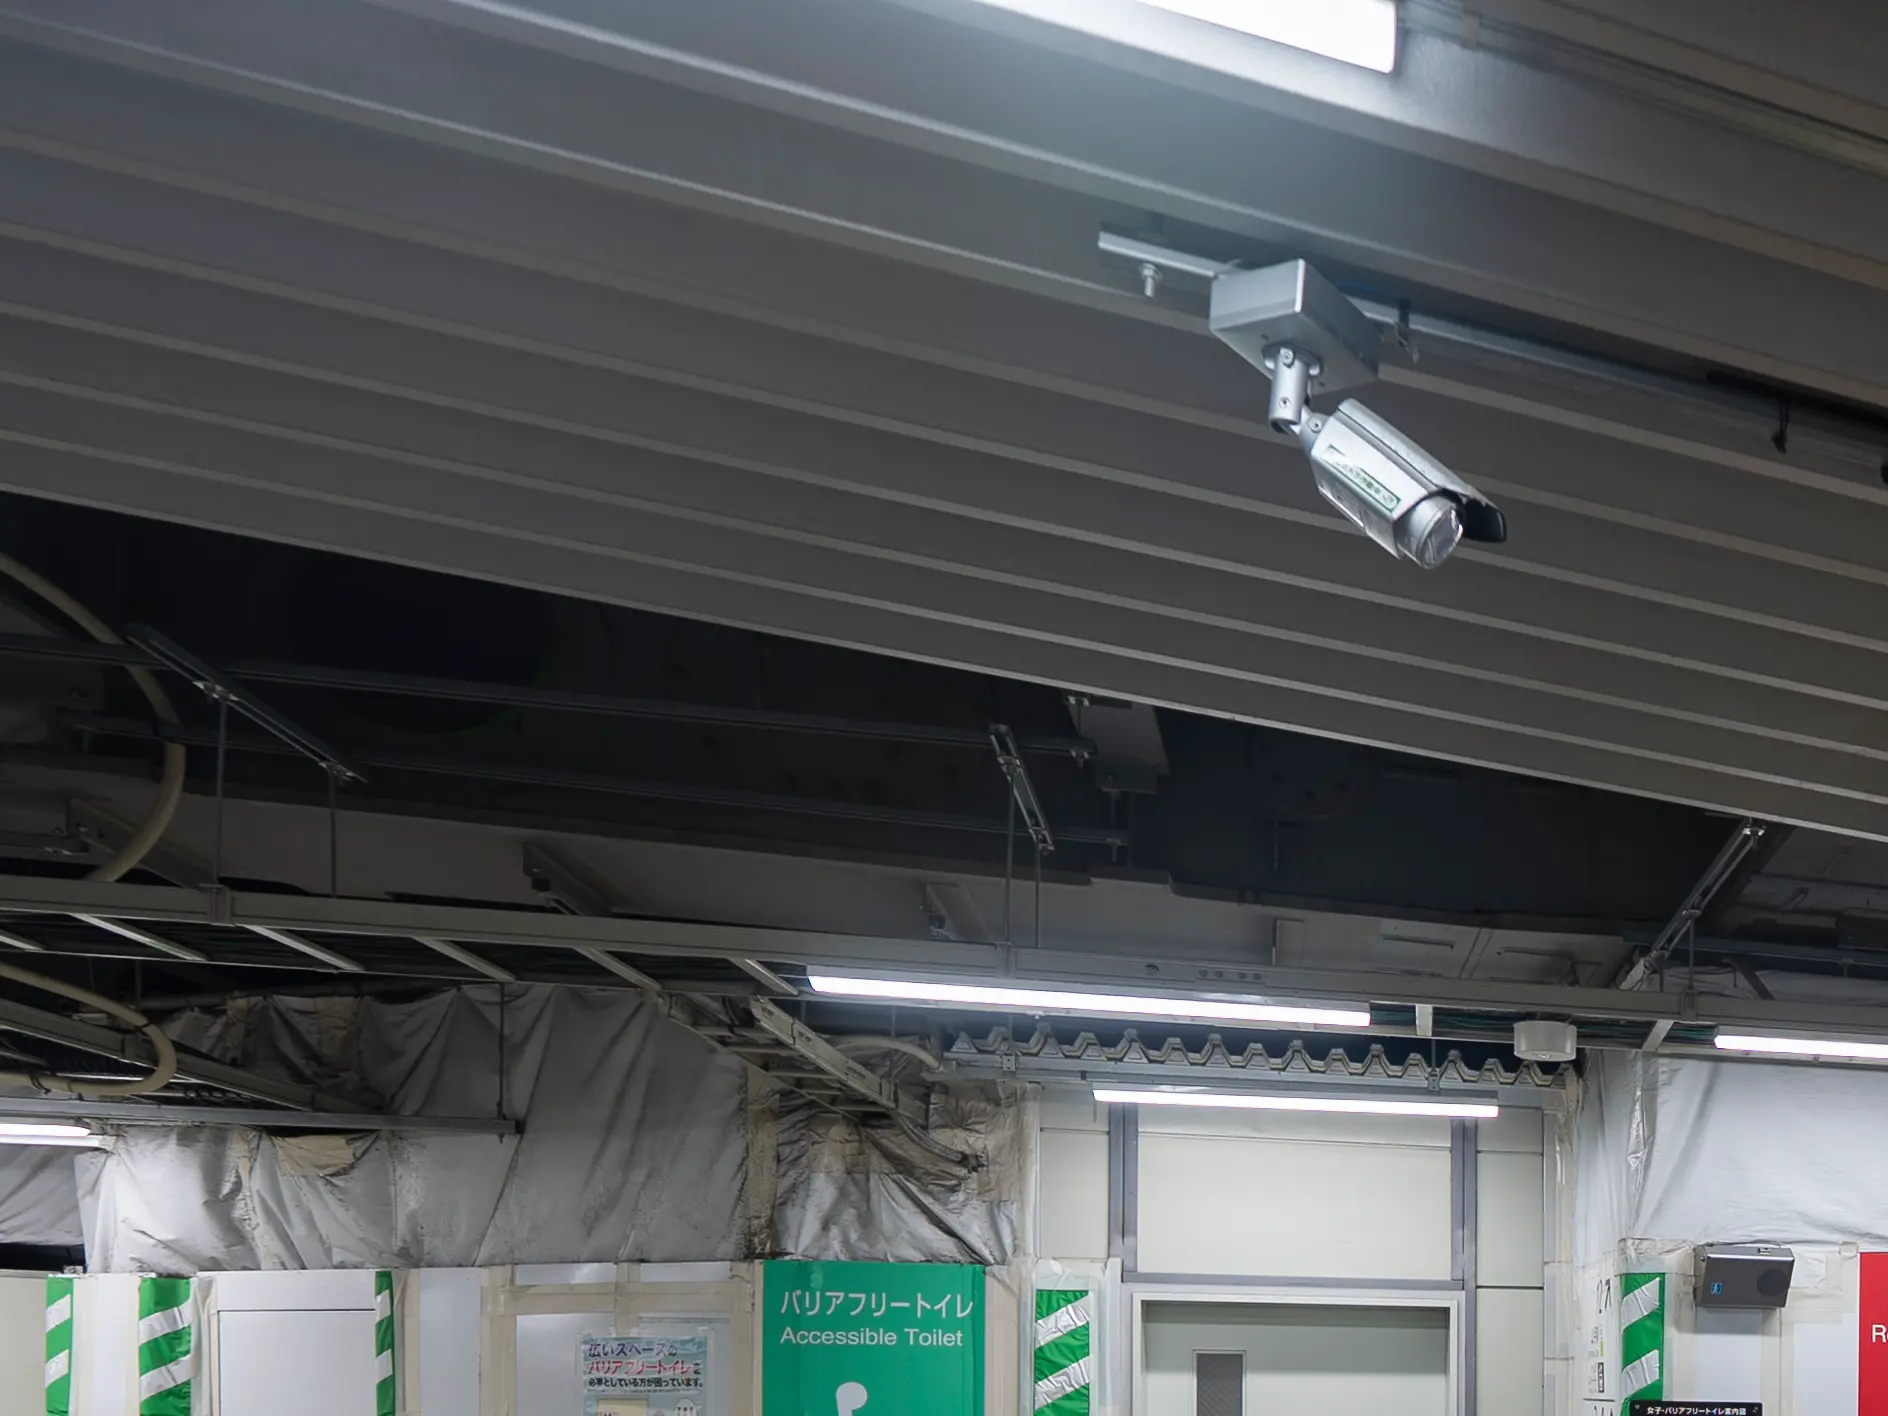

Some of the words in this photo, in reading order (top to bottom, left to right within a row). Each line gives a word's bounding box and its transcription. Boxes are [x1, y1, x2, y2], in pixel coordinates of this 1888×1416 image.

[780, 1290, 973, 1318] バリアフリートイレ
[780, 1327, 897, 1346] Accessible
[905, 1328, 963, 1347] Toilet
